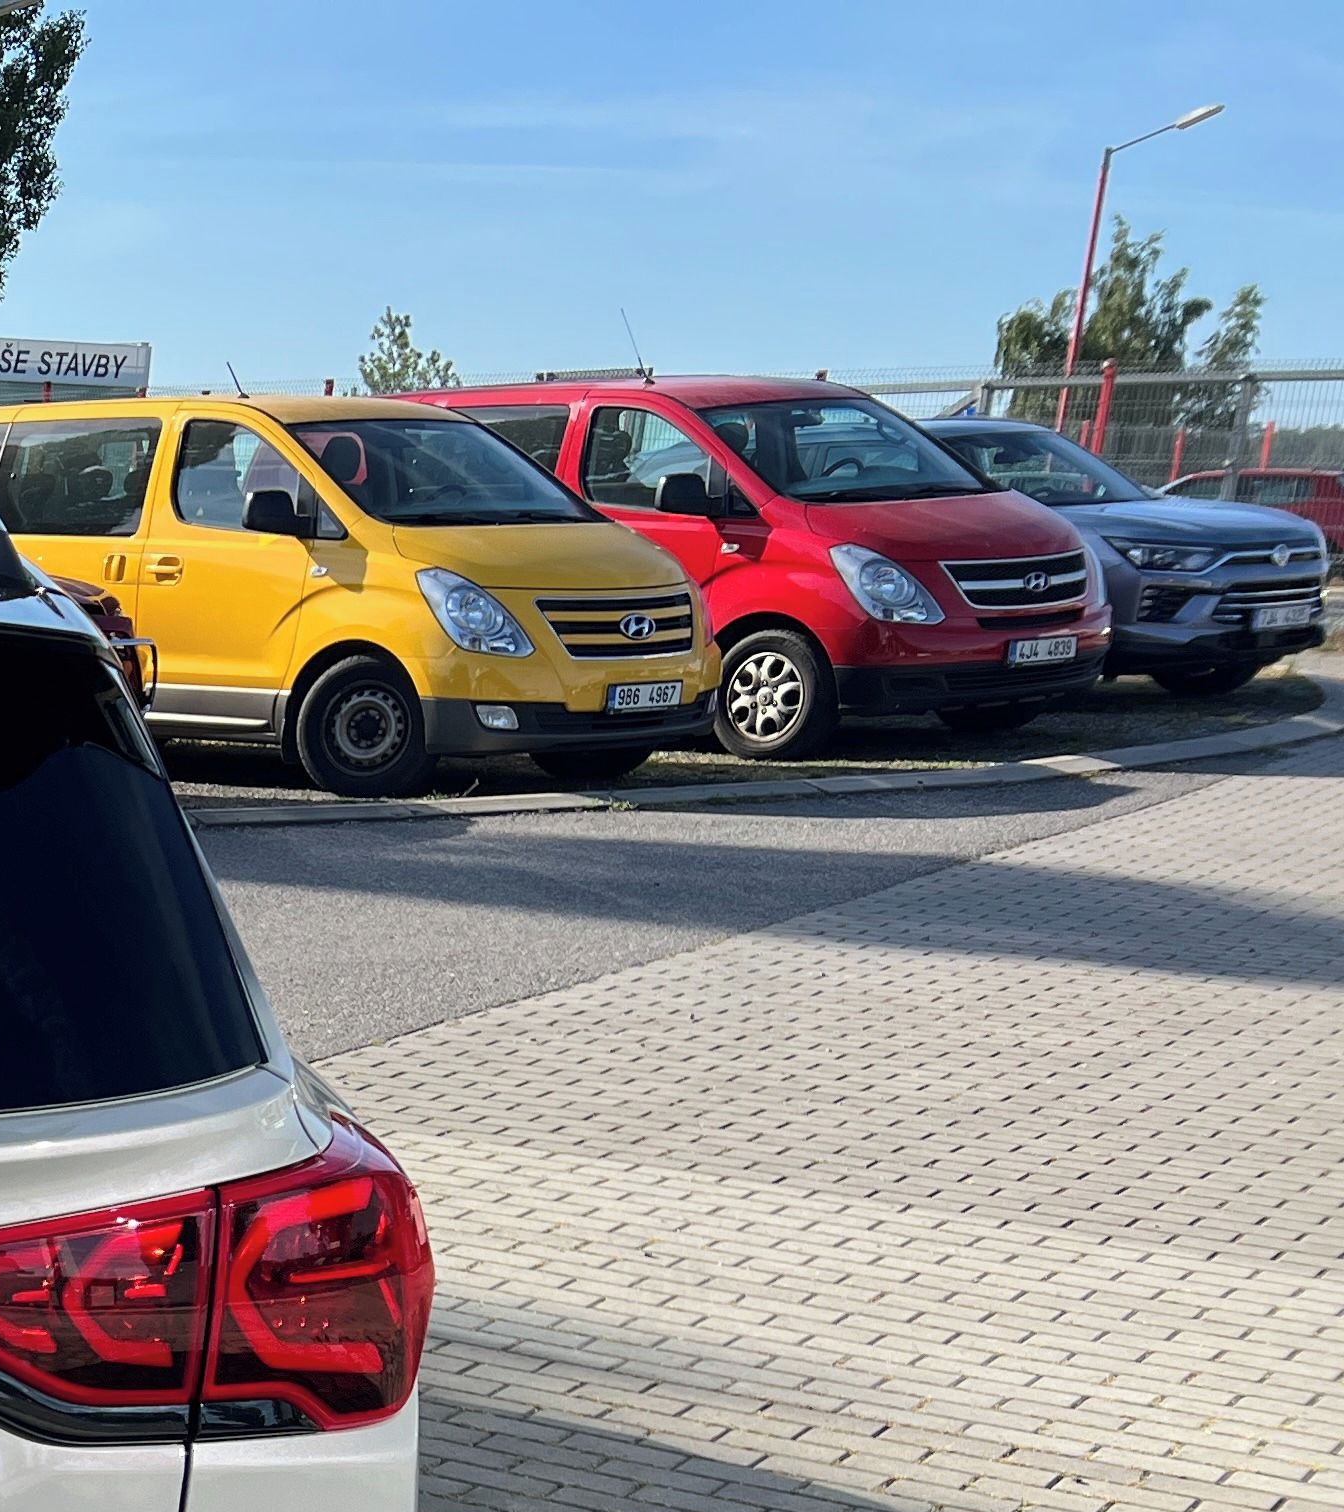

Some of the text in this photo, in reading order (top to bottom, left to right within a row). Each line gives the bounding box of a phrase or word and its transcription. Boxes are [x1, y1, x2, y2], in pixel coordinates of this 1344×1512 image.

[37, 351, 128, 379] STAVBY
[1047, 639, 1073, 657] 4839
[648, 685, 677, 704] 4967
